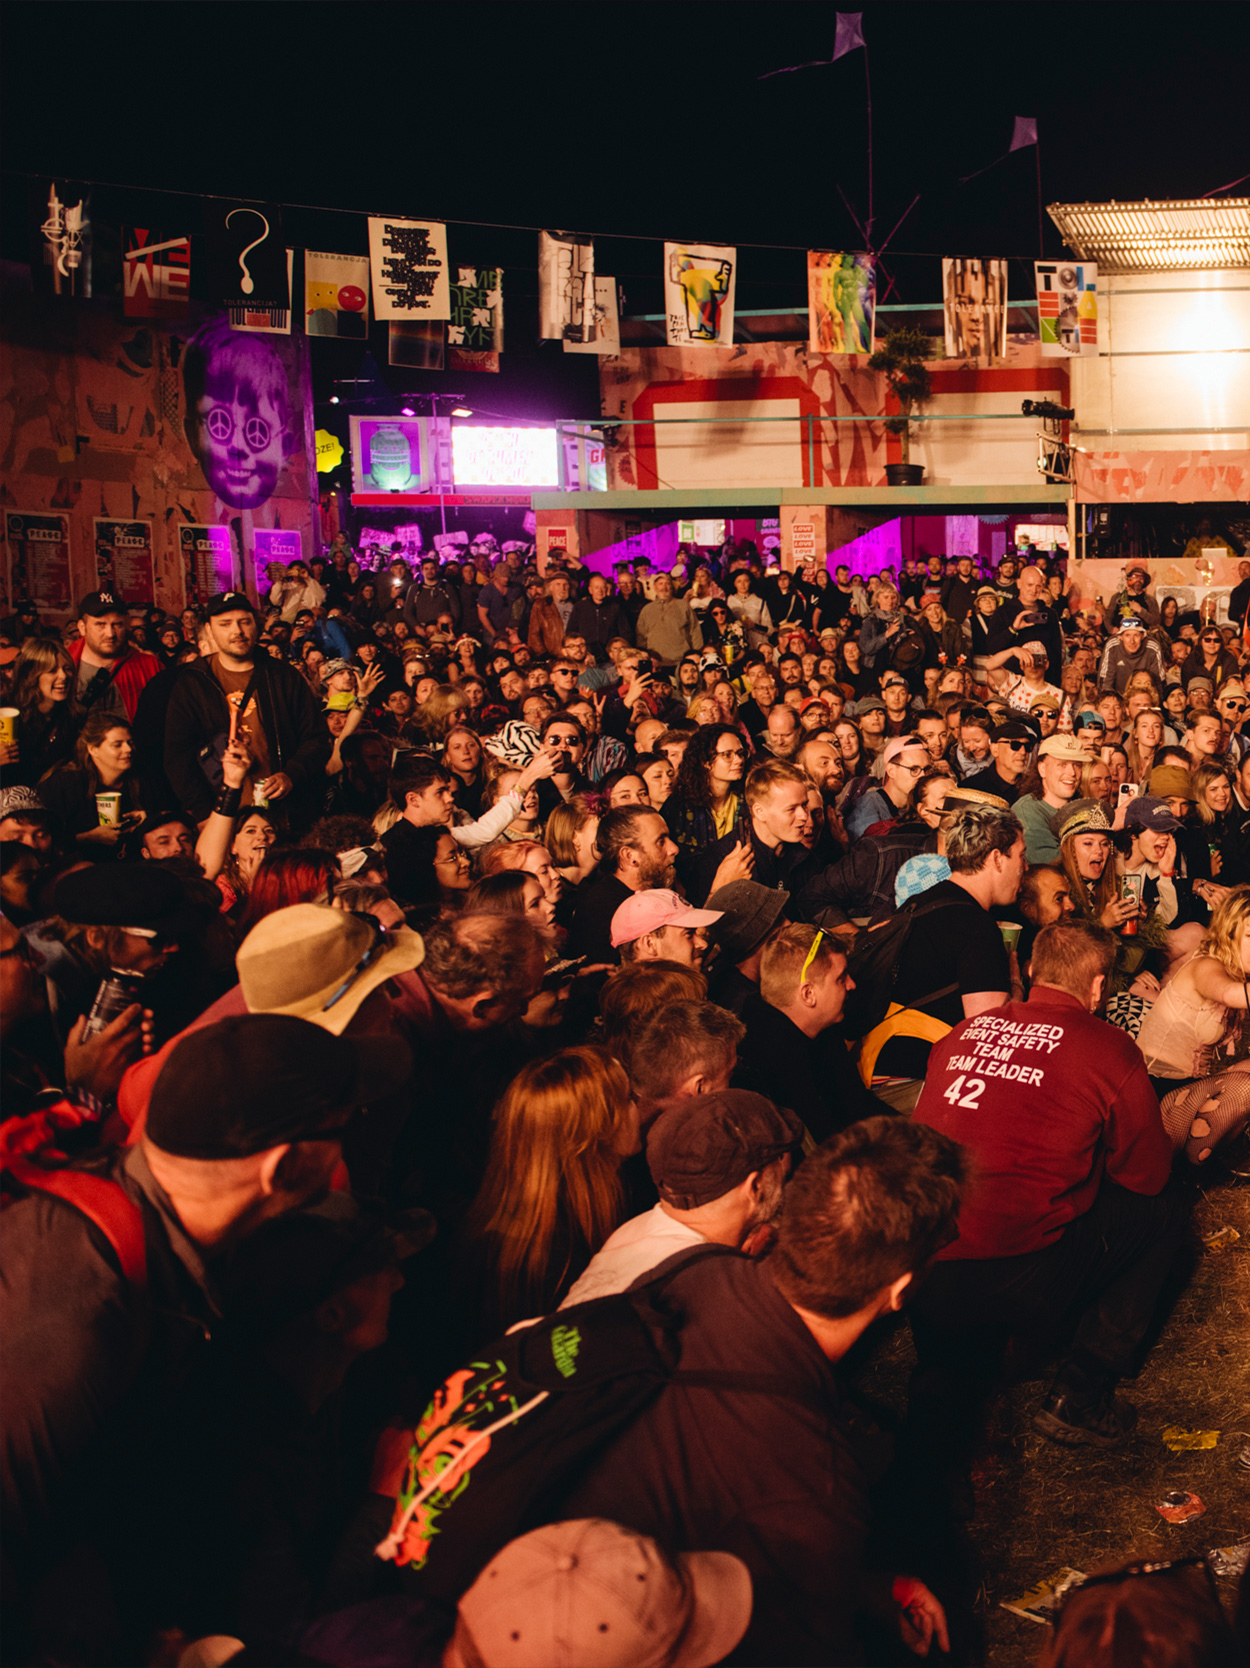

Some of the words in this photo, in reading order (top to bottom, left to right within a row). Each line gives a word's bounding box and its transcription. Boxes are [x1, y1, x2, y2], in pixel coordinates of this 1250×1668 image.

[308, 252, 367, 264] TOLERANCJA
[30, 530, 59, 539] PEACE
[116, 537, 143, 545] PEACE
[549, 536, 566, 547] PEACE
[970, 1016, 1064, 1040] SPECIALIZED
[960, 1028, 999, 1043] EVENT
[997, 1033, 1060, 1054] SAFETY
[973, 1042, 1015, 1062] TEAM
[946, 1055, 977, 1071] TEAM
[978, 1062, 1045, 1087] LEADER
[943, 1075, 986, 1110] 42
